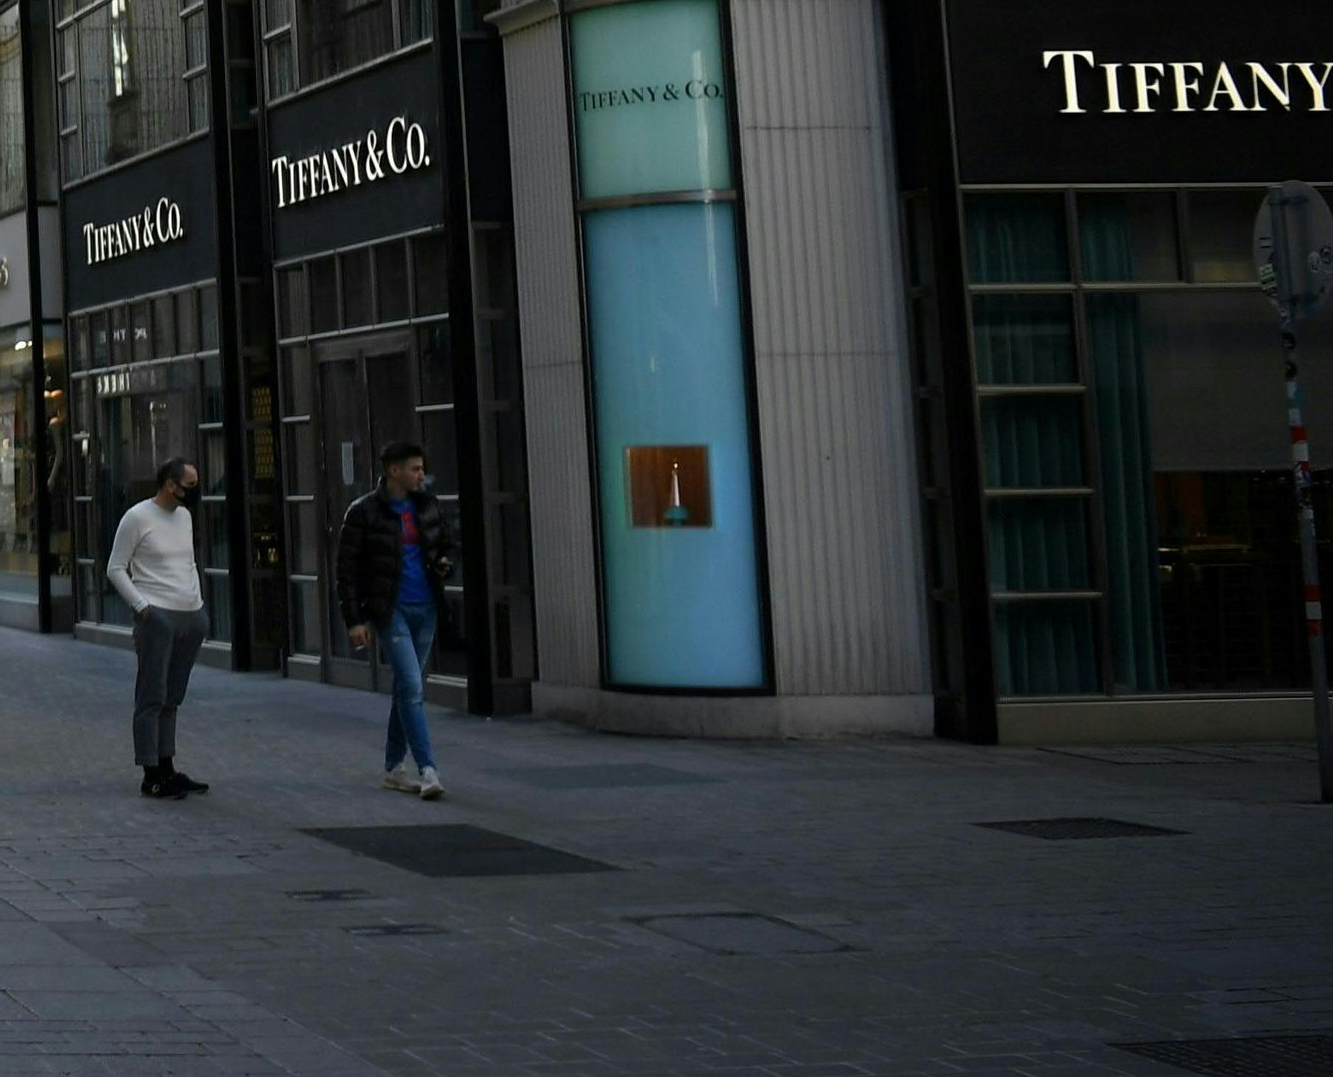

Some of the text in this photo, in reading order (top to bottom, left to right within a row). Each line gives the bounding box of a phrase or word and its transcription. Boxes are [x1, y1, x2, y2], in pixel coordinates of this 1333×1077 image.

[579, 85, 659, 112] TIFFANY
[662, 83, 680, 101] &
[1042, 50, 1333, 114] TIFFANY
[272, 139, 363, 209] TIFFANY
[365, 129, 384, 182] &
[83, 213, 144, 266] TIFFANY
[142, 205, 155, 249] &
